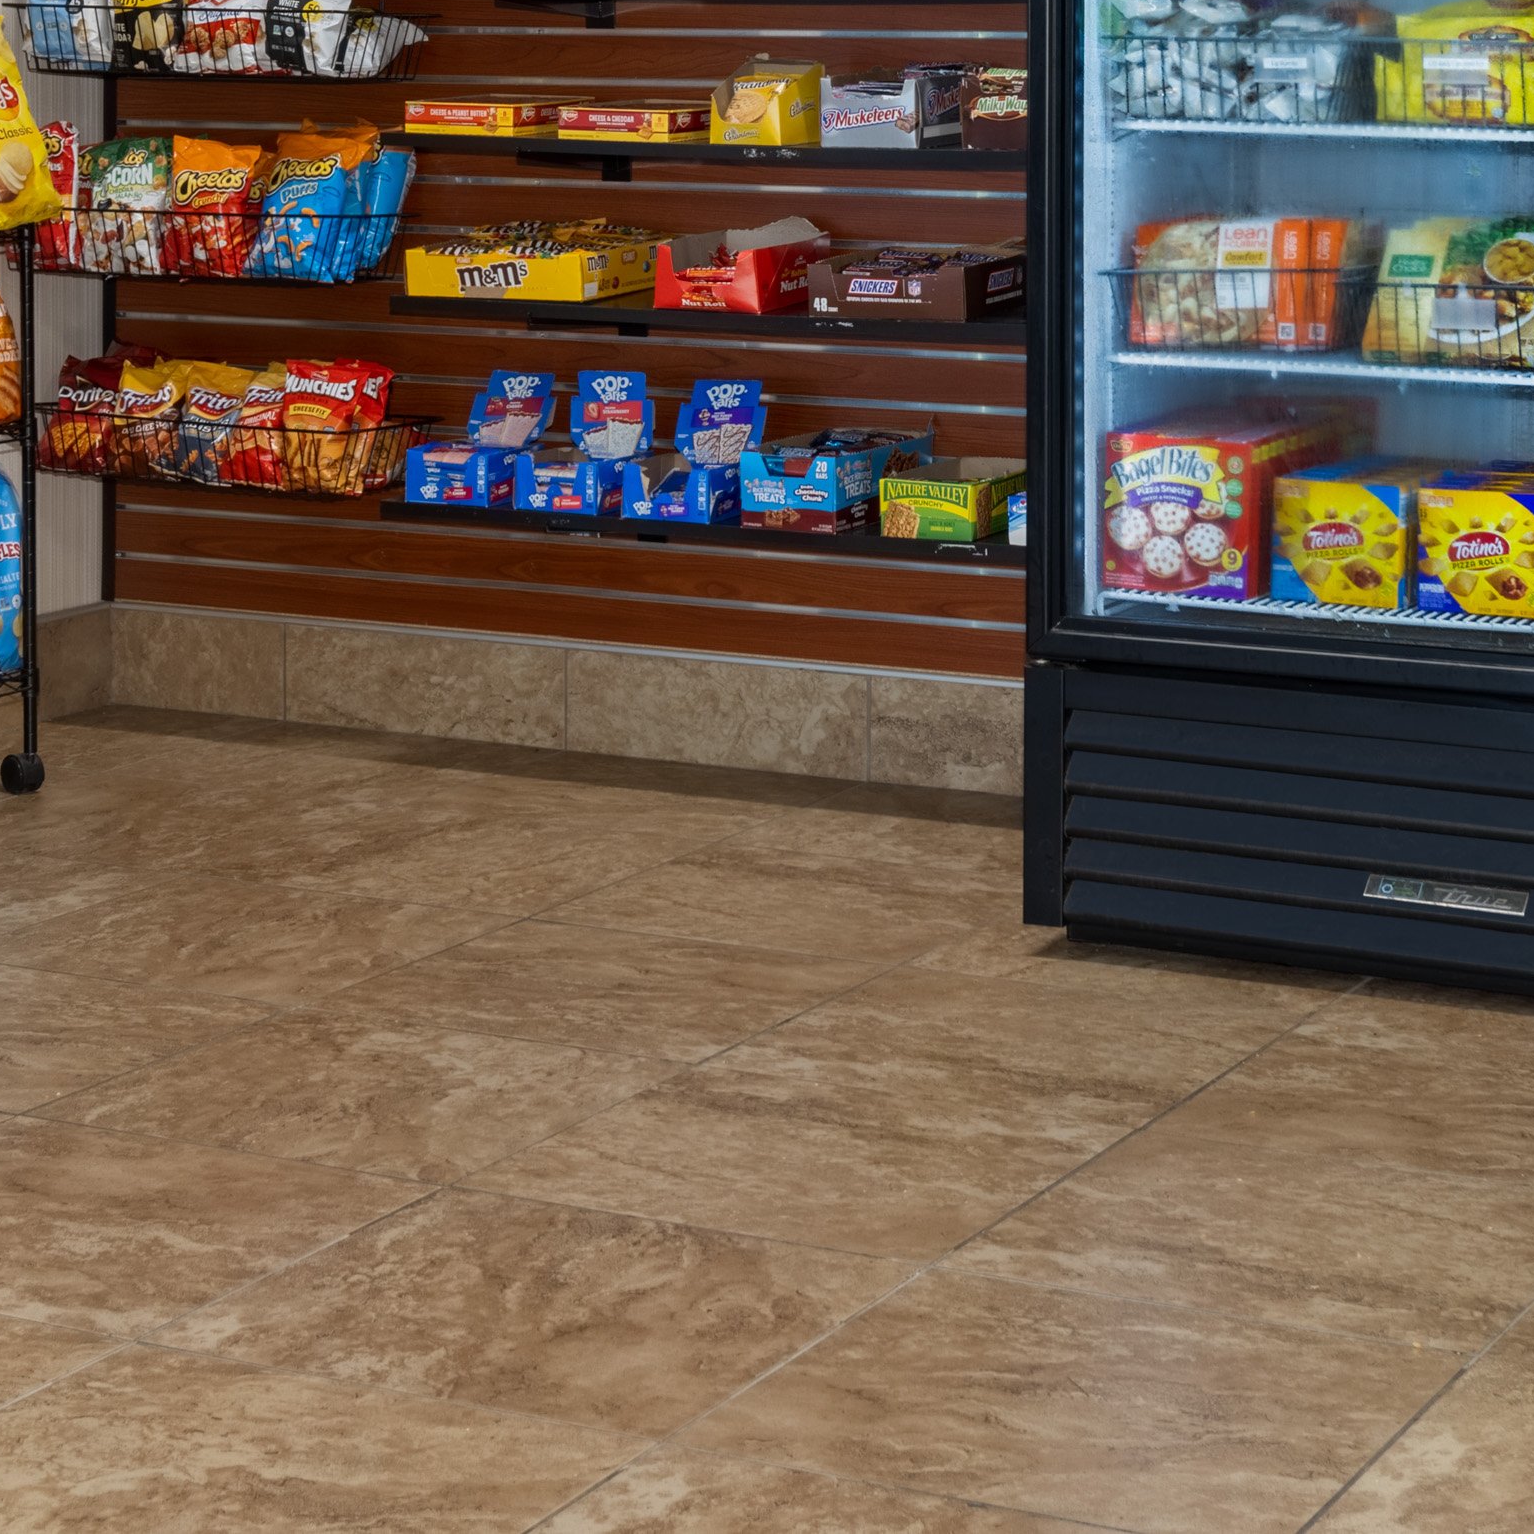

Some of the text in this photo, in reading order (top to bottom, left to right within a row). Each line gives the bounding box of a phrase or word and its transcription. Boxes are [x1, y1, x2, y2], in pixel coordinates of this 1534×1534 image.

[834, 107, 905, 128] Musketeers
[269, 158, 340, 193] Cheetos
[174, 170, 248, 205] Cheetos
[280, 184, 318, 203] PUFFS
[1225, 252, 1265, 263] Comfort
[850, 280, 897, 294] SNICKERS
[681, 299, 726, 309] Nut Roll
[813, 297, 828, 312] 48
[285, 372, 357, 401] MUNCHIES
[815, 461, 828, 472] 20
[1113, 447, 1214, 488] Bagel Bites
[754, 493, 785, 504] TREATS
[886, 482, 967, 506] NATURE VALLEY
[908, 499, 944, 508] CRUNCHY
[1308, 526, 1359, 548] Totino's
[1453, 536, 1505, 558] Totino's
[1227, 552, 1238, 565] 9
[1452, 559, 1478, 569] PIZZA
[1434, 888, 1511, 909] true
